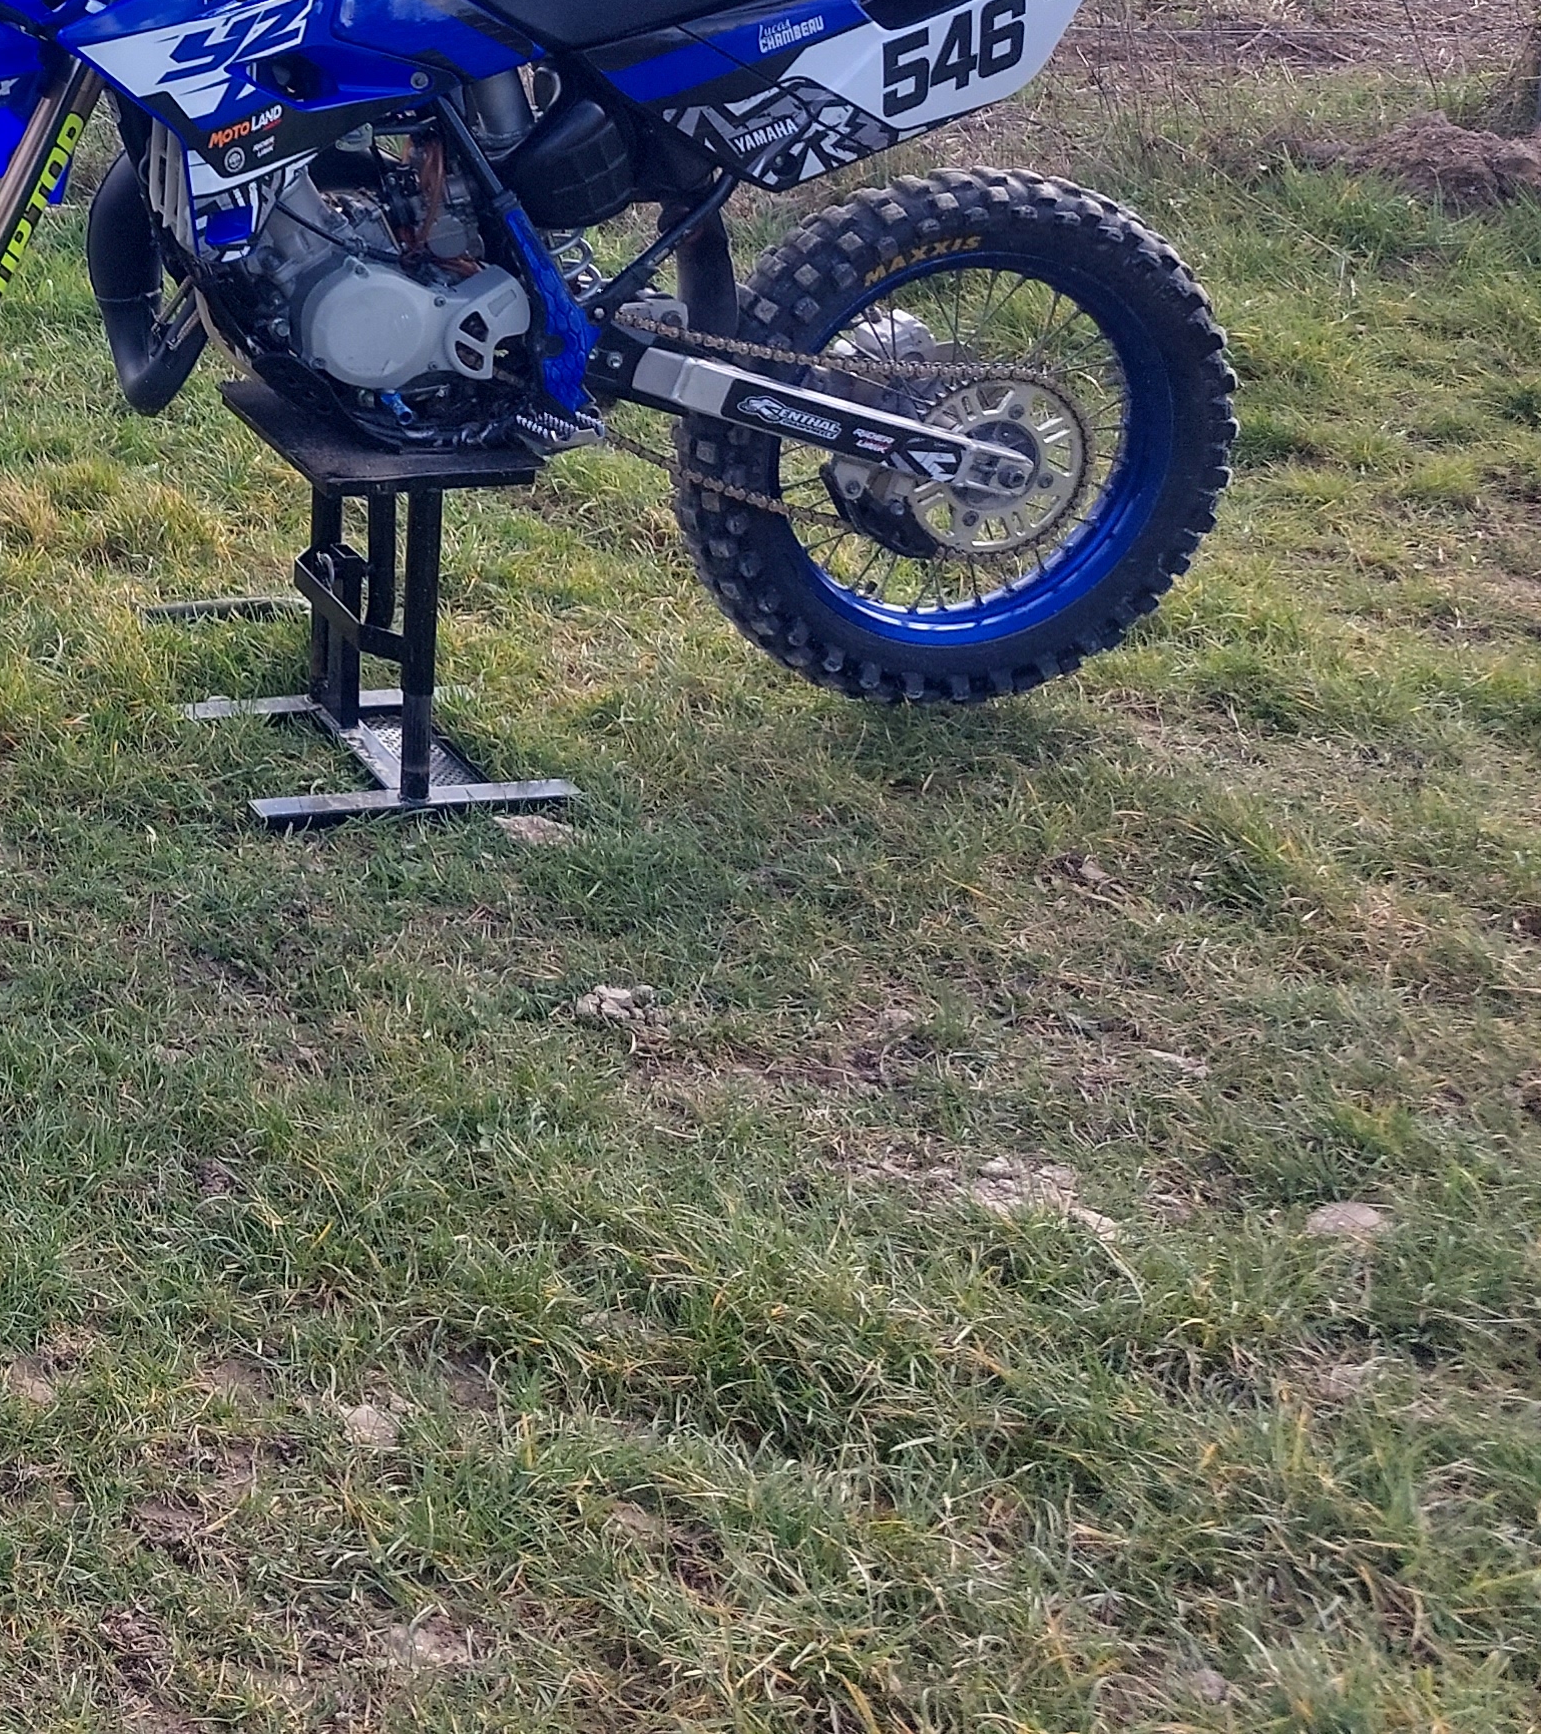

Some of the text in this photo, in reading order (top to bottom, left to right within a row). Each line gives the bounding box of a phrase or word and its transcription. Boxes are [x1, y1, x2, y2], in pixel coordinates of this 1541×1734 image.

[758, 16, 825, 54] CHAMBEAU
[208, 104, 284, 149] MOTO LAND
[733, 117, 799, 155] YAMAHA
[863, 235, 982, 287] MAXXIS
